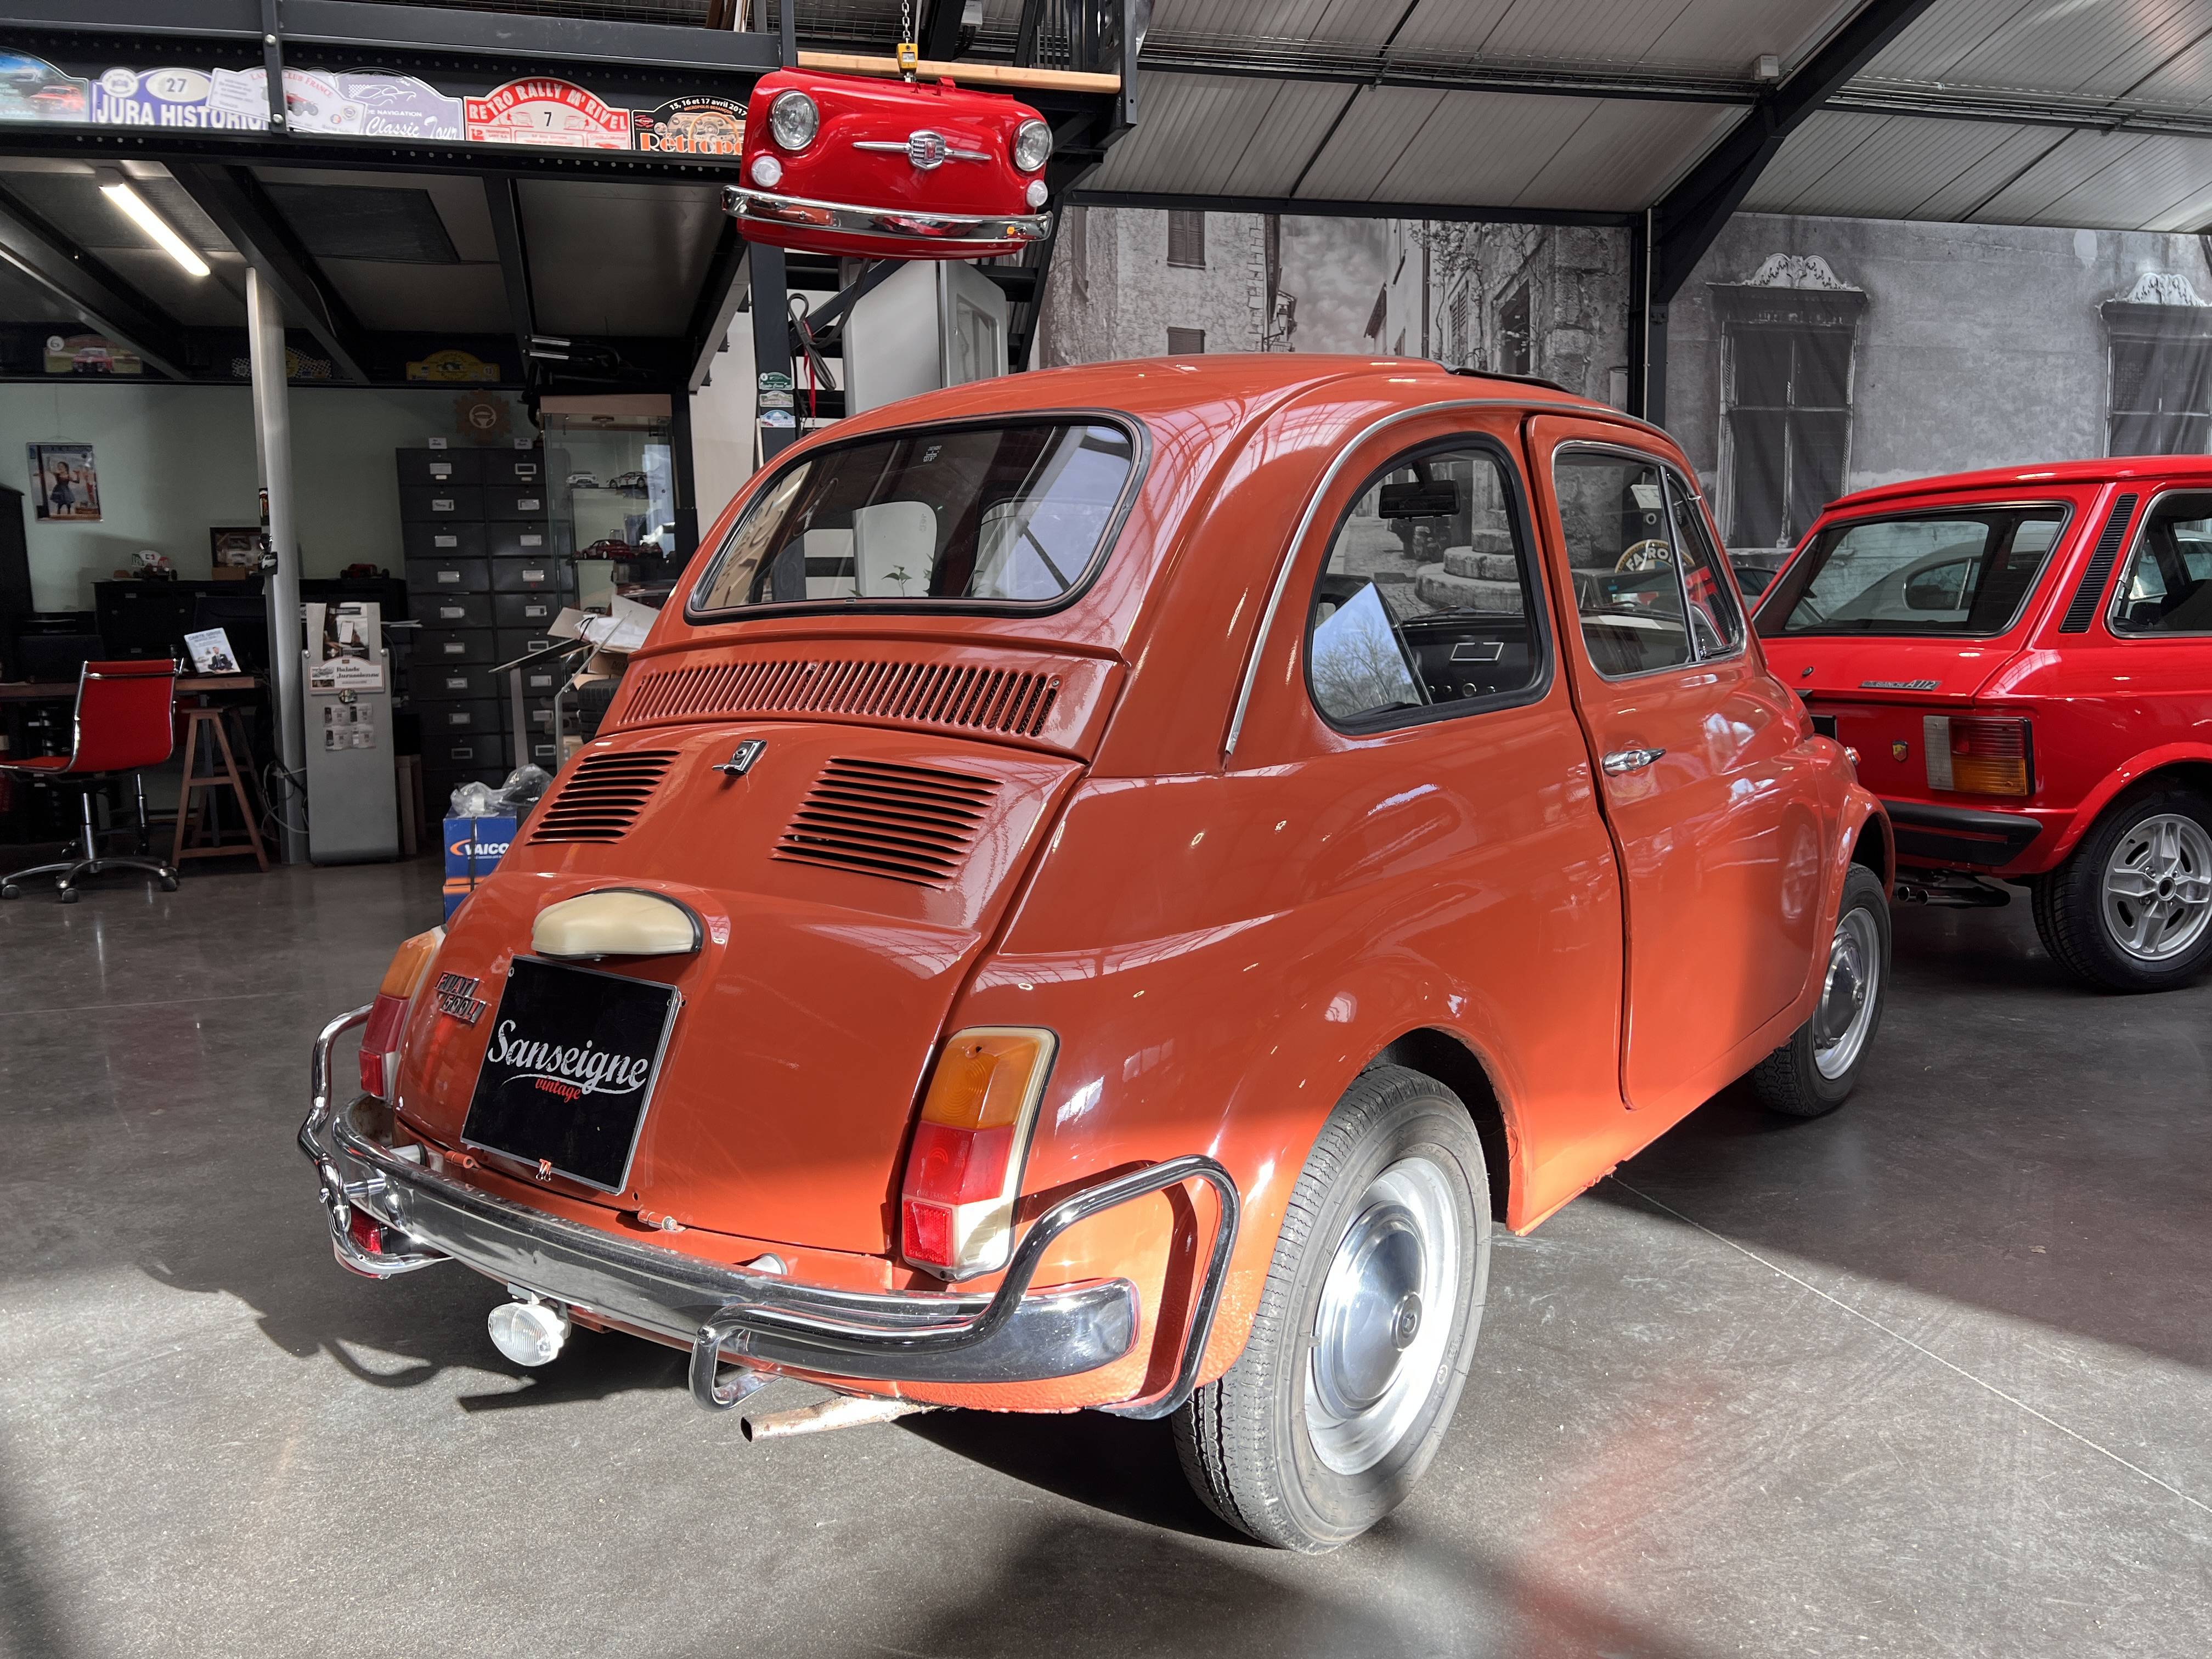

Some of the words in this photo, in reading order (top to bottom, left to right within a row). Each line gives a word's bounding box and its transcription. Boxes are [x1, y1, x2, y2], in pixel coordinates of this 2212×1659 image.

[166, 77, 187, 93] 27
[305, 77, 333, 97] FRANCE
[97, 94, 155, 126] JURA
[469, 90, 514, 120] RETRO
[515, 82, 563, 99] RALLY
[669, 102, 681, 111] 15,
[711, 99, 729, 108] avril
[729, 103, 748, 116] 2017
[366, 116, 420, 137] Classic
[424, 116, 458, 139] Tour
[544, 111, 552, 127] 7
[1905, 679, 1936, 690] A112
[465, 843, 510, 856] VAICO
[436, 973, 473, 996] FIAT
[443, 995, 481, 1020] 500L
[487, 1019, 648, 1095] Sanseigne
[535, 1075, 582, 1103] vintage
